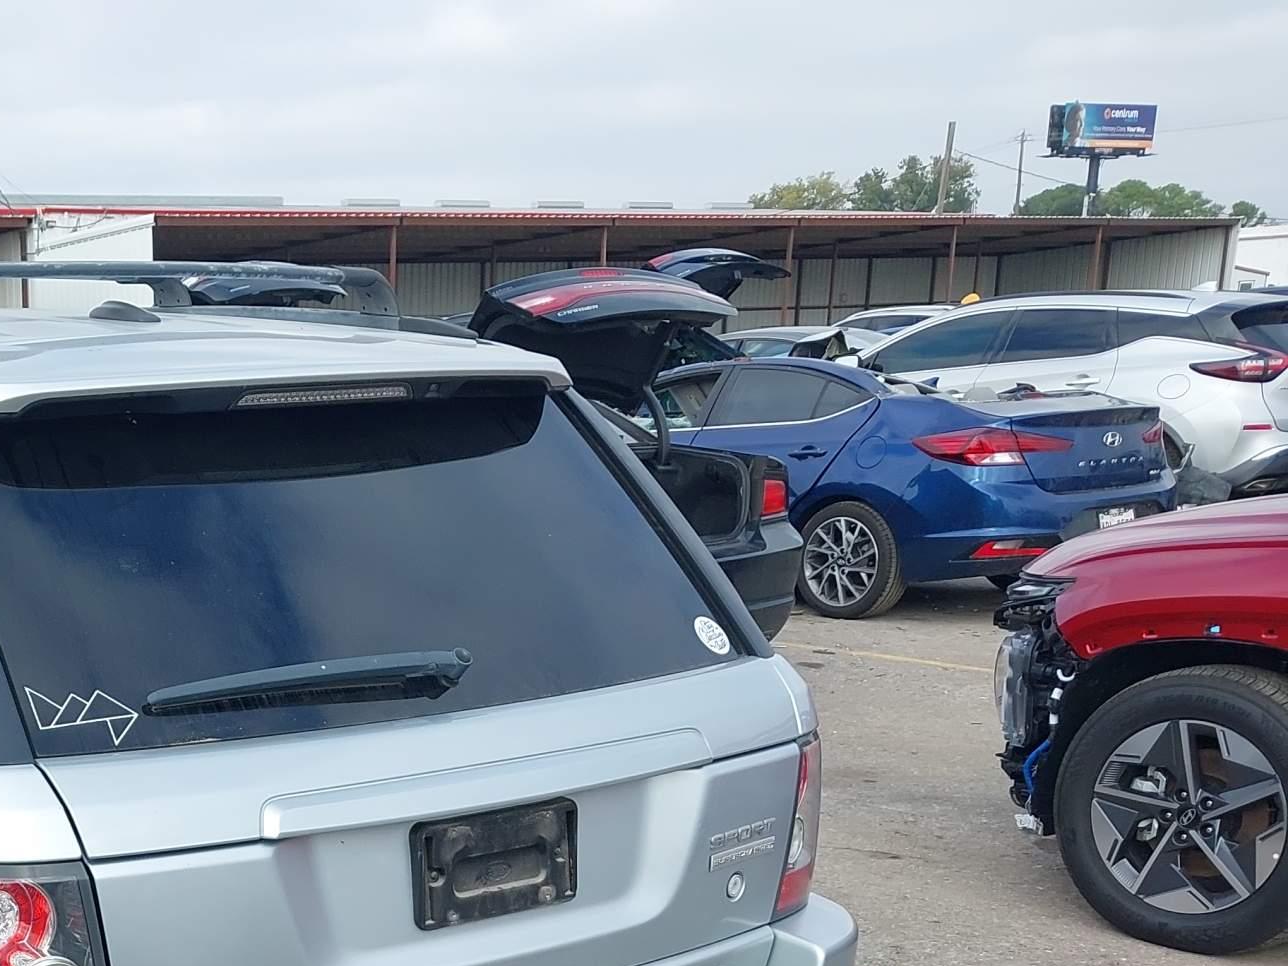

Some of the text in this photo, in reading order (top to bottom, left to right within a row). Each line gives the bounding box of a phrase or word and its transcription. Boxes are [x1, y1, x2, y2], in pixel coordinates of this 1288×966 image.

[556, 304, 599, 317] CHARGER
[1078, 456, 1144, 467] ELANTRA
[710, 817, 776, 849] SPORT
